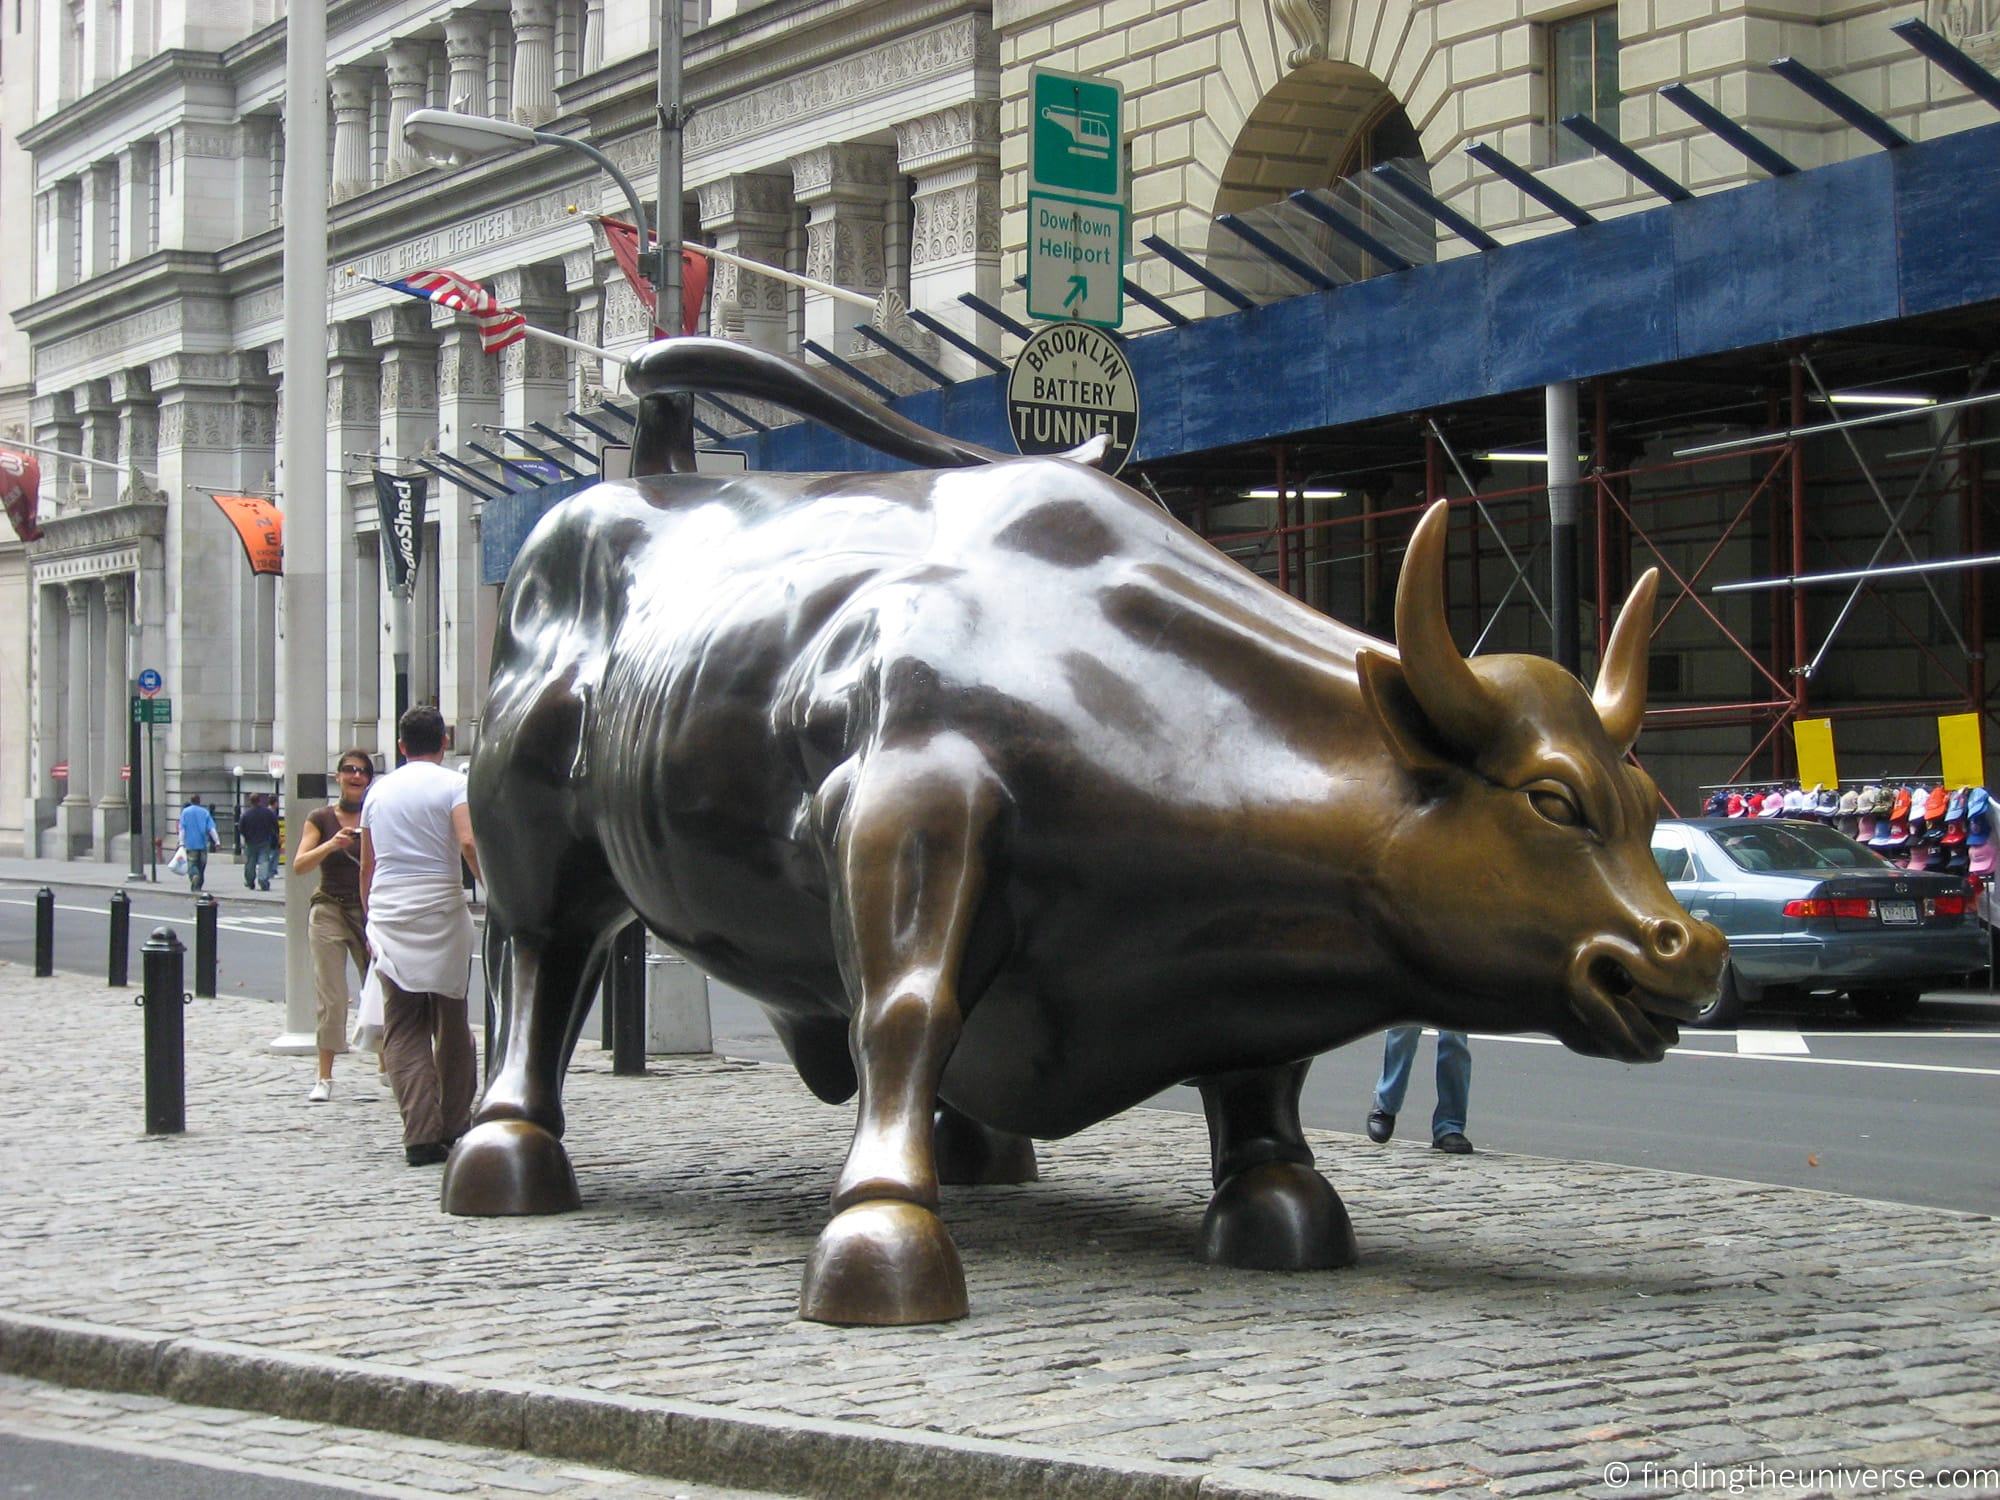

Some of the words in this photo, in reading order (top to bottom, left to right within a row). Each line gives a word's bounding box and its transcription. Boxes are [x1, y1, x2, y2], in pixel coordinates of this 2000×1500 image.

[399, 235, 440, 270] GREEN
[449, 212, 505, 254] OFFICES
[1040, 208, 1112, 238] Downtown
[1039, 237, 1111, 265] Heliport
[1025, 328, 1123, 382] BROOKLYN
[1033, 375, 1116, 407] BATTERY
[1016, 406, 1127, 450] TUNNEL
